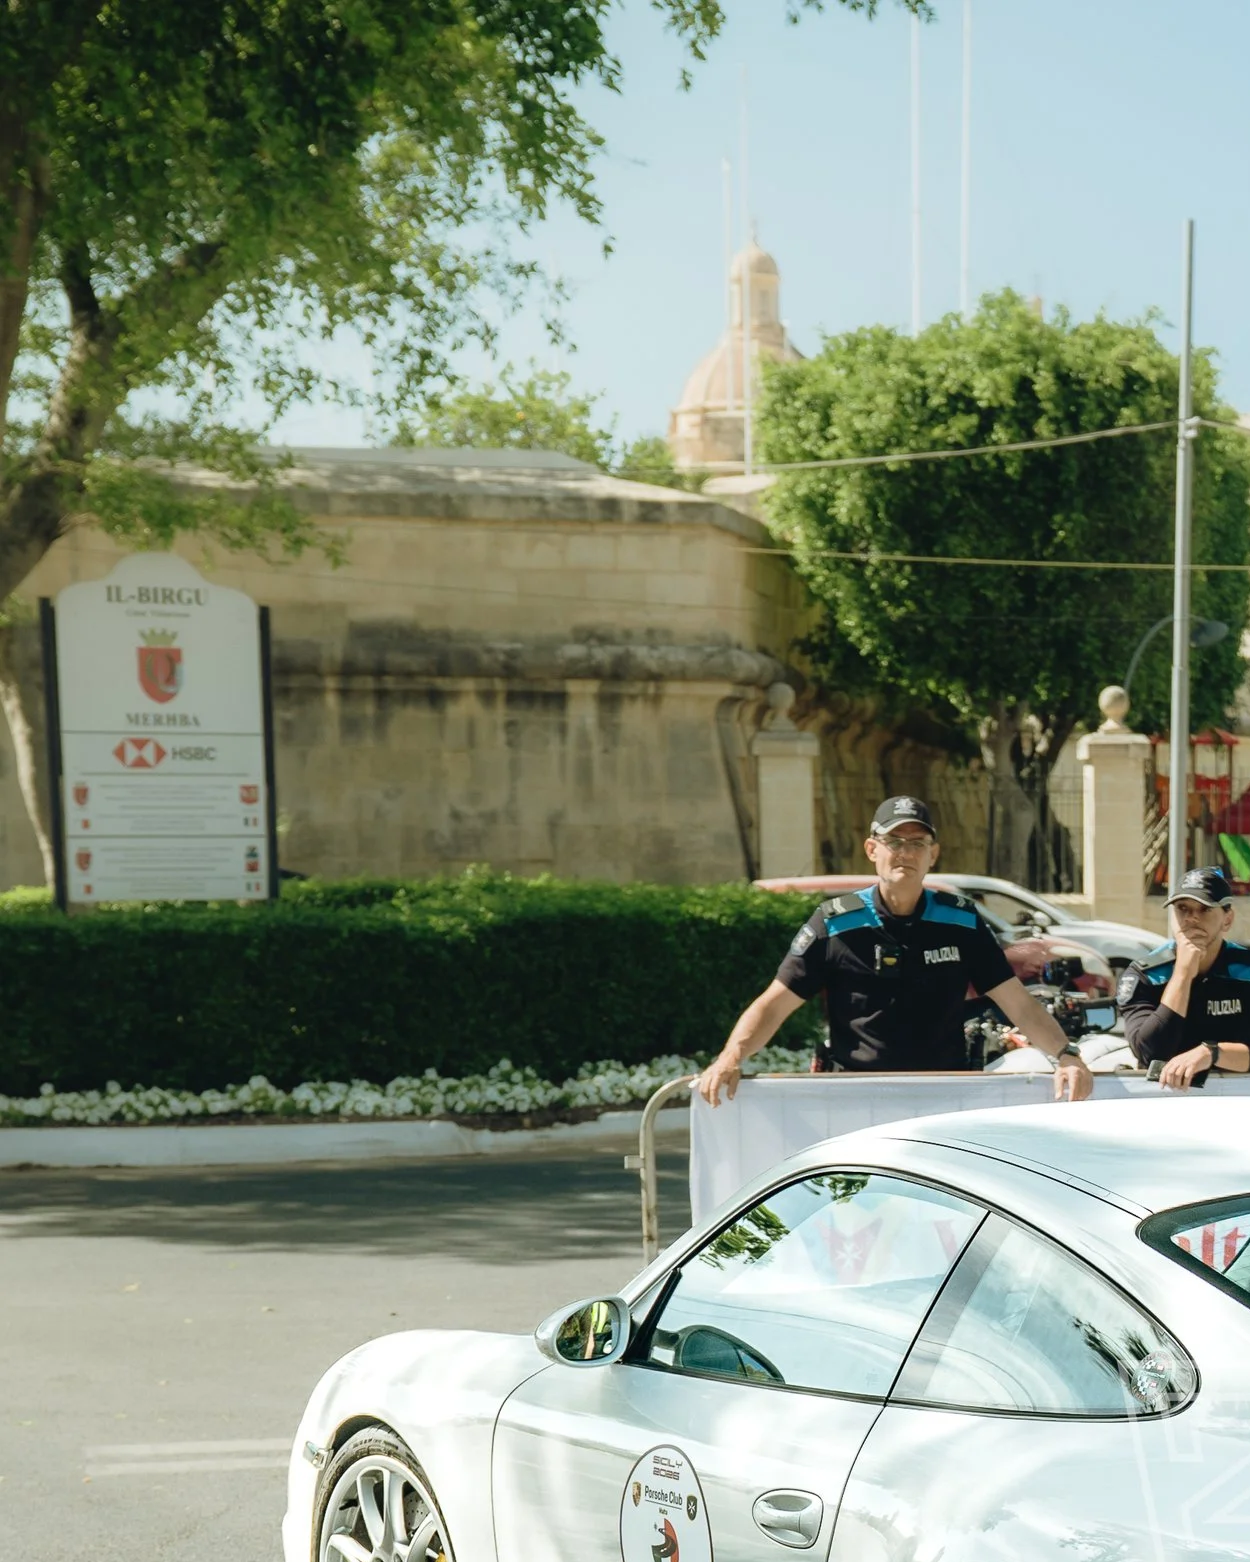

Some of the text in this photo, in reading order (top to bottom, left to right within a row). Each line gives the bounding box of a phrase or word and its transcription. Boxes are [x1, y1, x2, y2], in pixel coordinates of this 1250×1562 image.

[105, 585, 210, 606] IL-BIRGU
[125, 712, 203, 727] MERHBA
[171, 746, 217, 761] HSBC
[923, 946, 961, 965] PULIZIJA
[1206, 998, 1242, 1016] PULIZIJA
[644, 1485, 683, 1506] Porsche Club
